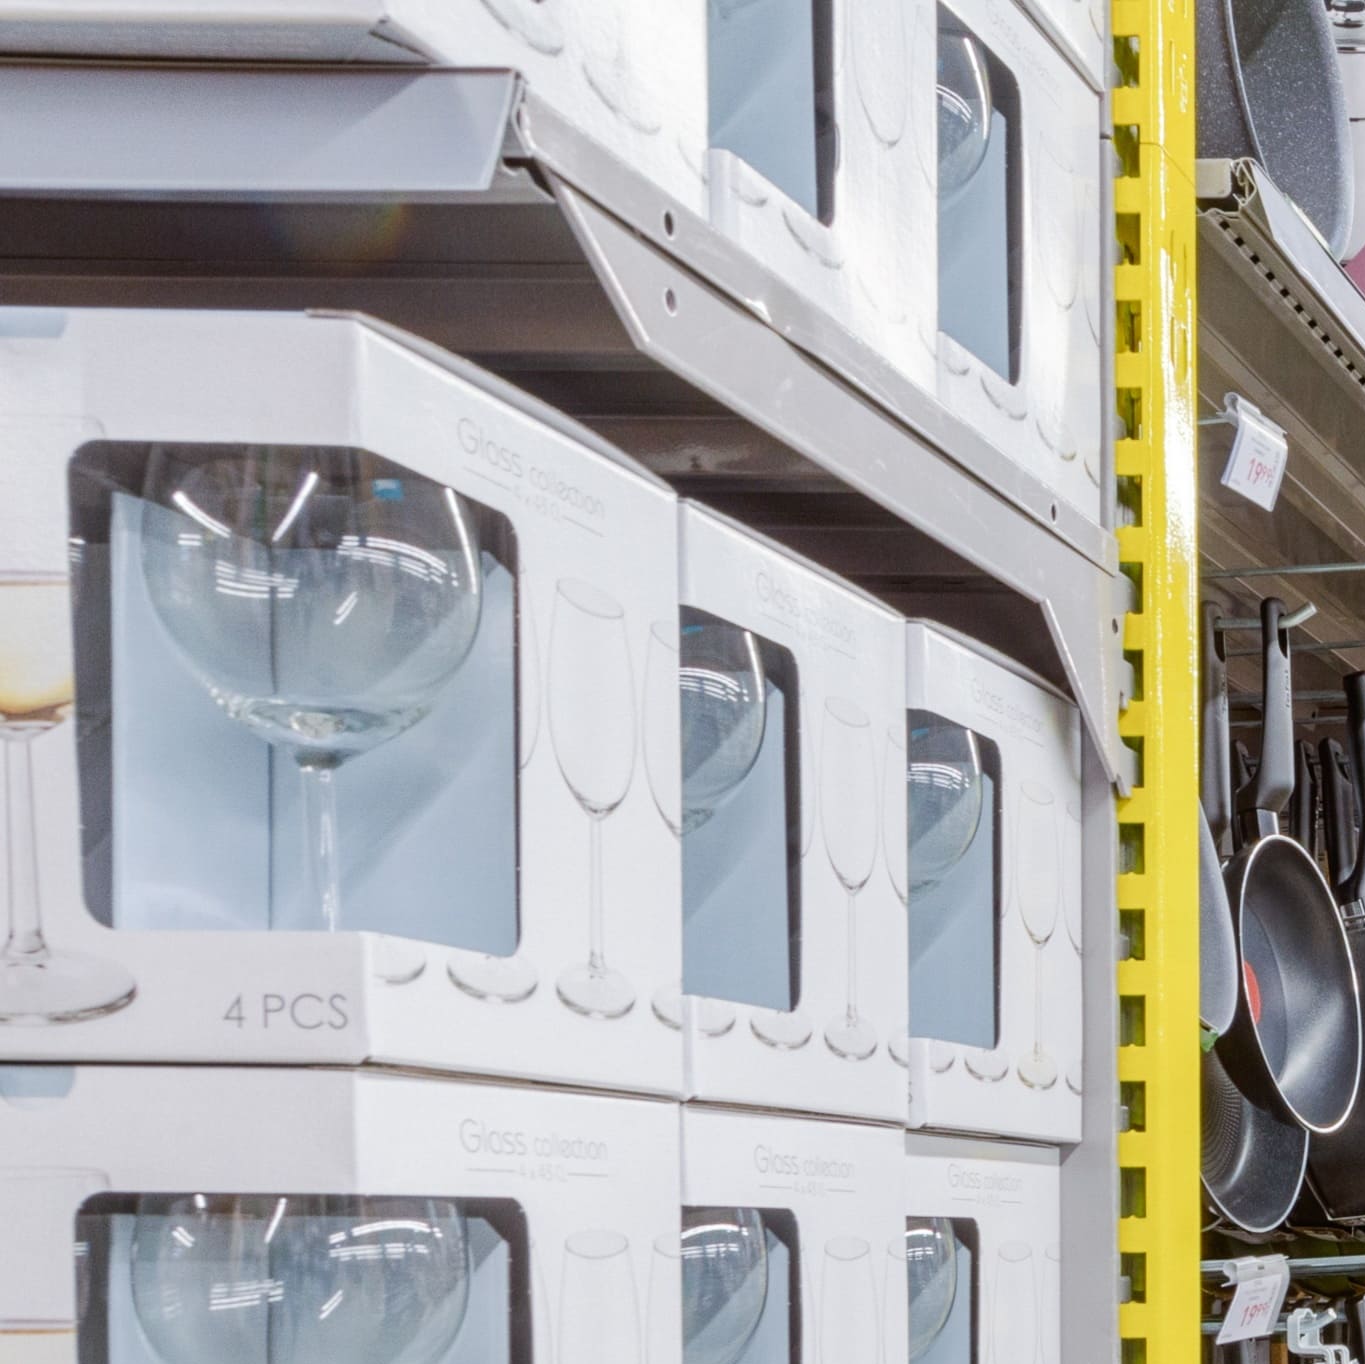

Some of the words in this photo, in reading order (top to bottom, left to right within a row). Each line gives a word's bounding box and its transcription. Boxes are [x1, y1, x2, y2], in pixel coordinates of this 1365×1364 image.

[223, 993, 245, 1029] 4
[263, 993, 350, 1031] PCS
[458, 1117, 529, 1156] Glass
